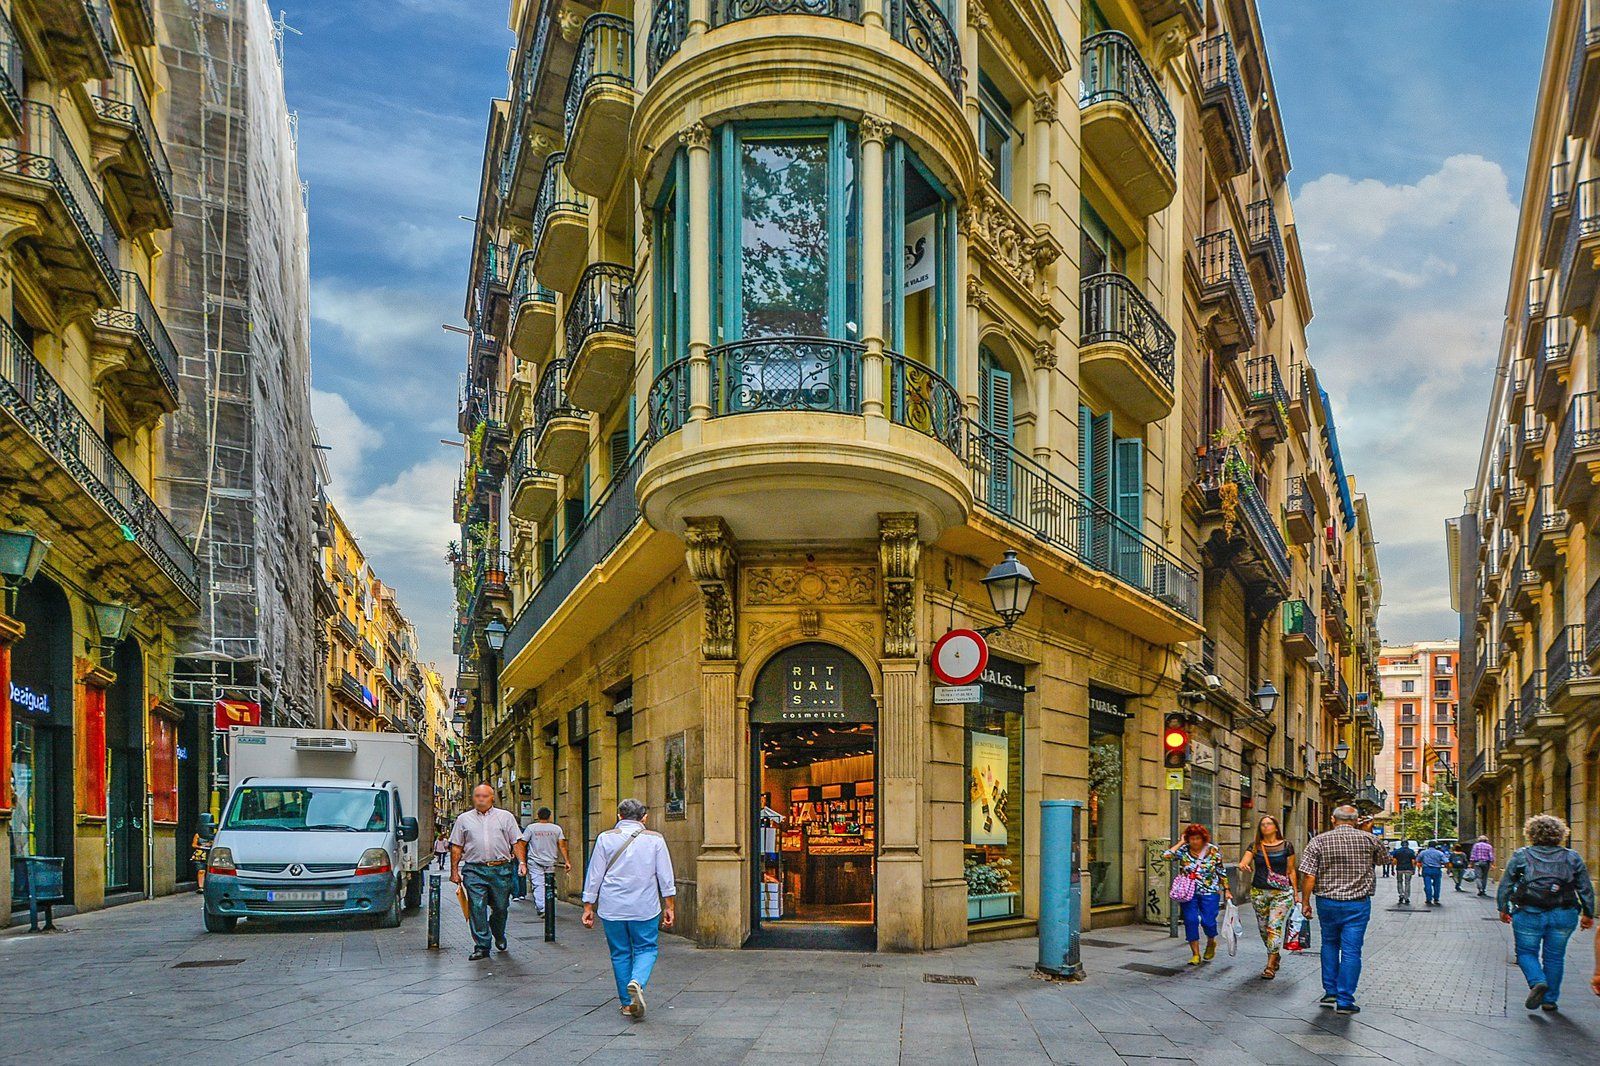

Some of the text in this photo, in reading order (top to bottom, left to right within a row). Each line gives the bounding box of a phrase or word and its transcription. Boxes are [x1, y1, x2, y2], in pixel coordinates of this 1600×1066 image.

[910, 274, 929, 286] VIAJES
[792, 666, 834, 676] RIT
[792, 681, 834, 690] UAL
[980, 668, 1028, 692] UALS...
[1090, 698, 1128, 718] TUALS...
